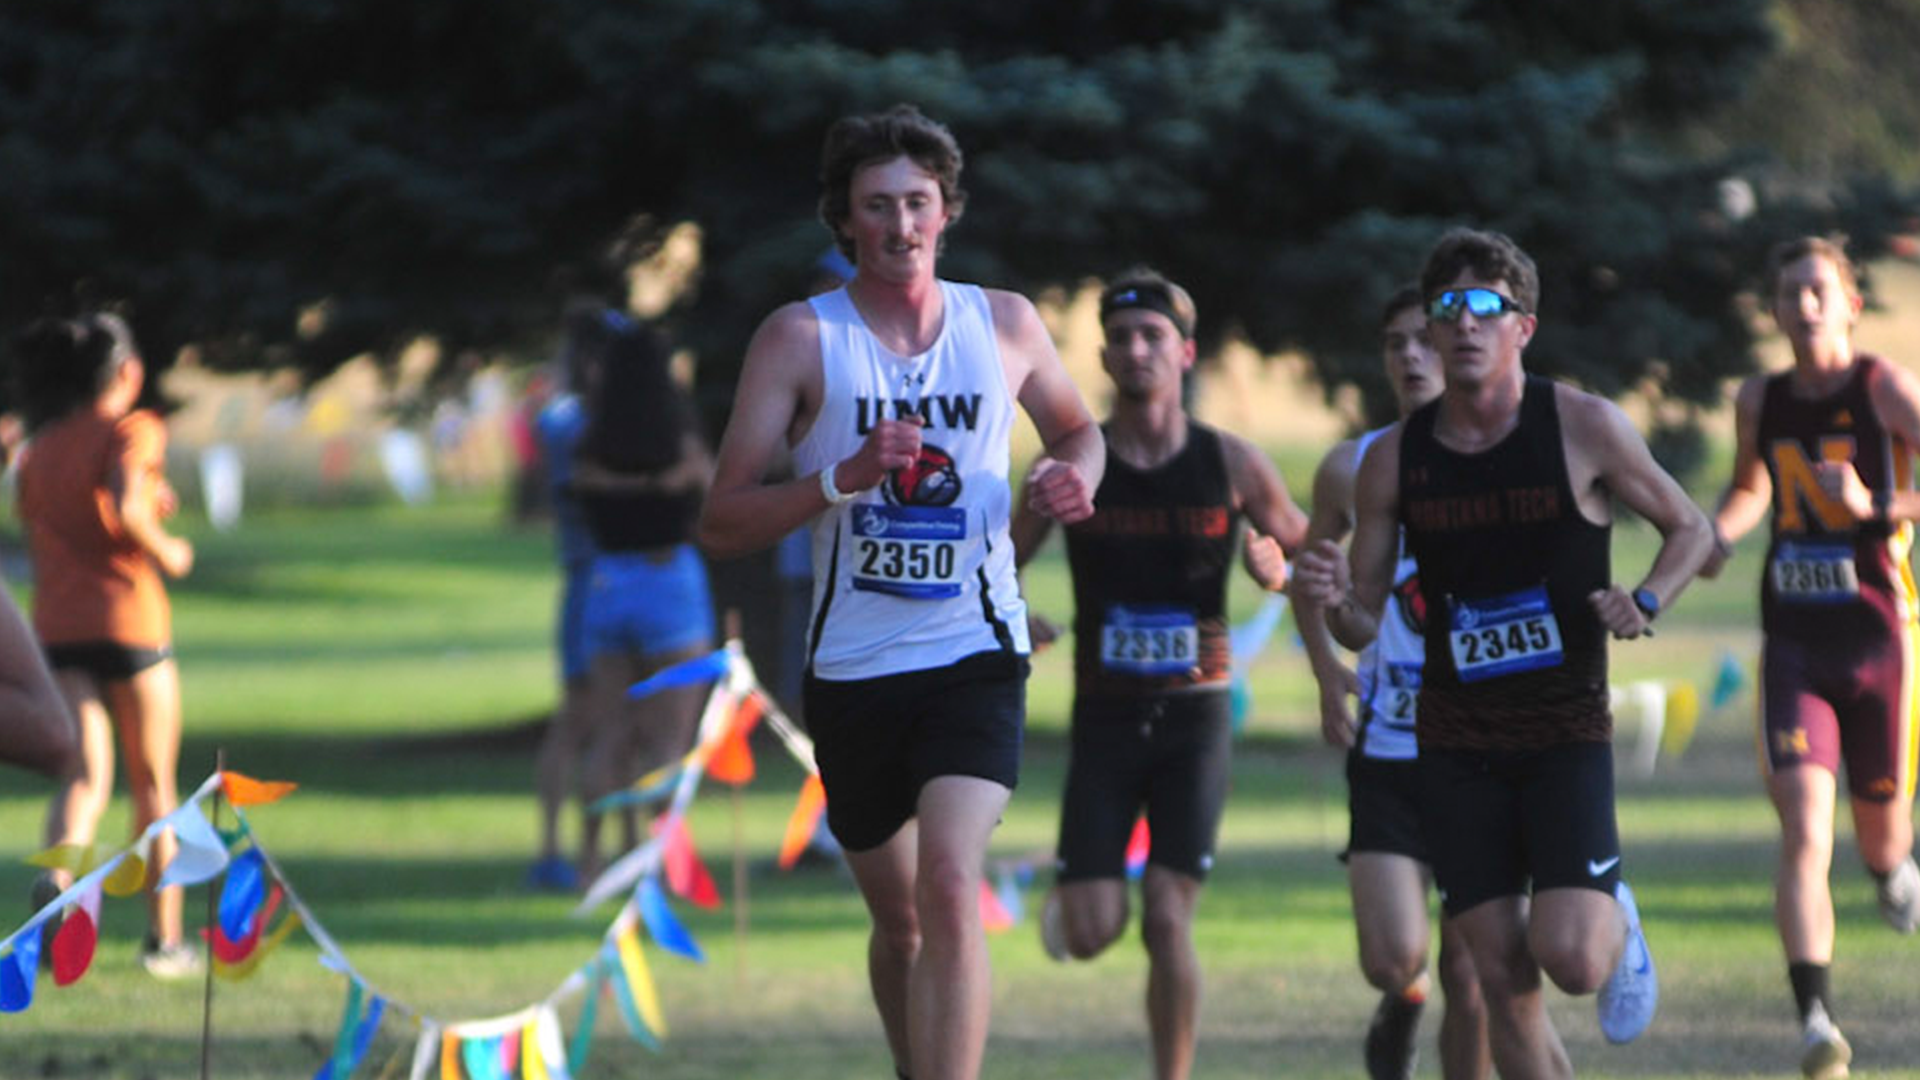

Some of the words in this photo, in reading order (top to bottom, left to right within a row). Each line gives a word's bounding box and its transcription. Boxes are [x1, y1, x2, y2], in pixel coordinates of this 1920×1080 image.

[856, 394, 982, 435] UMW
[1506, 485, 1560, 521] TECH
[1773, 437, 1855, 531] N
[860, 539, 955, 580] 2350
[1460, 619, 1552, 664] 2345
